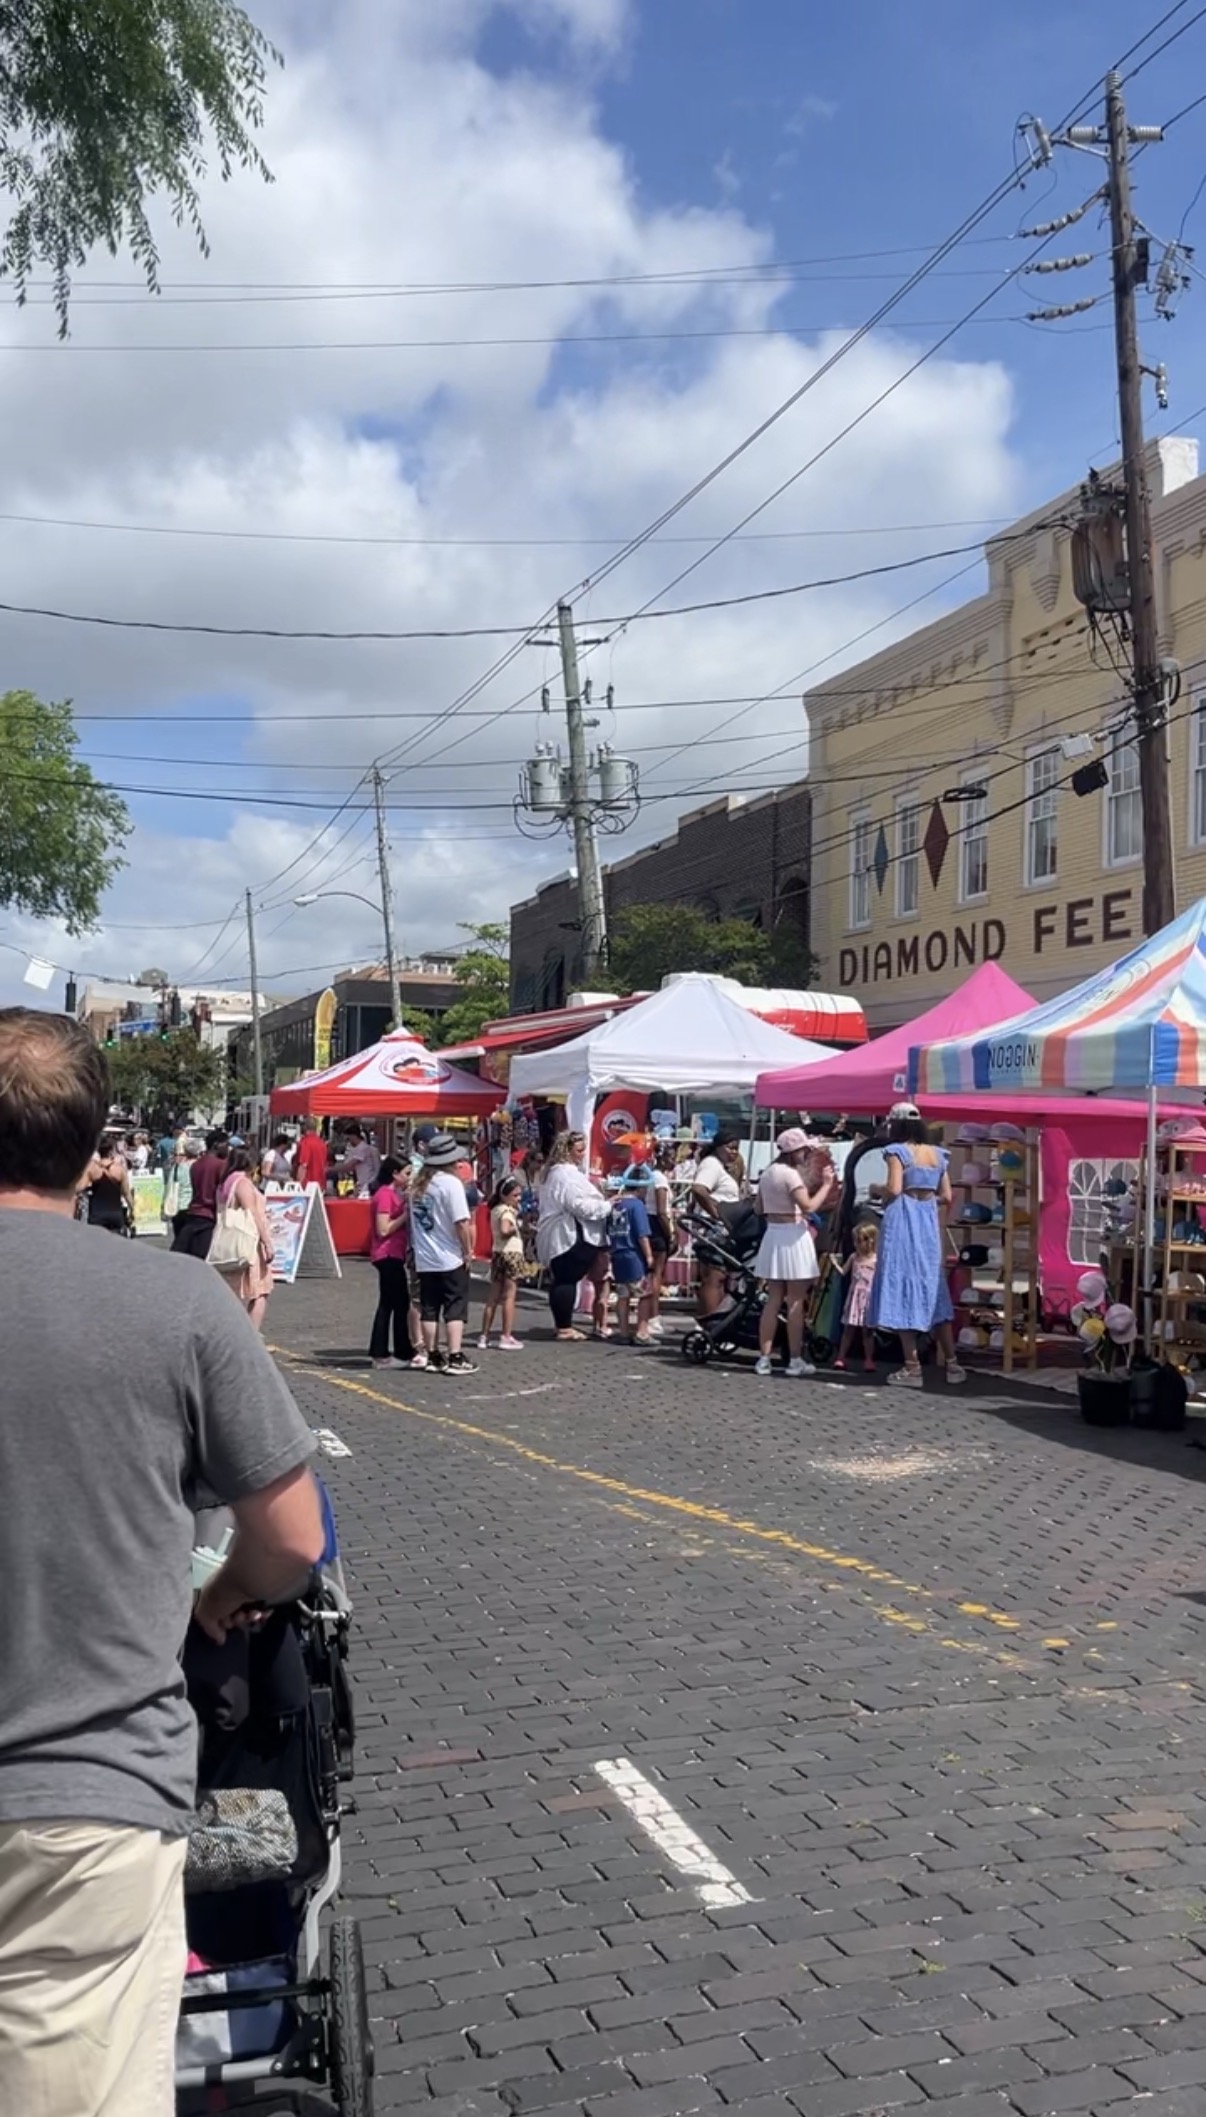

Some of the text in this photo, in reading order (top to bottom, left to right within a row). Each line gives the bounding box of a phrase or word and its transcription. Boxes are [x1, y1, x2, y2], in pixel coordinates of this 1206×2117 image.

[839, 889, 1148, 986] DIAMOND FEE
[987, 1043, 1036, 1069] NOGGIN
